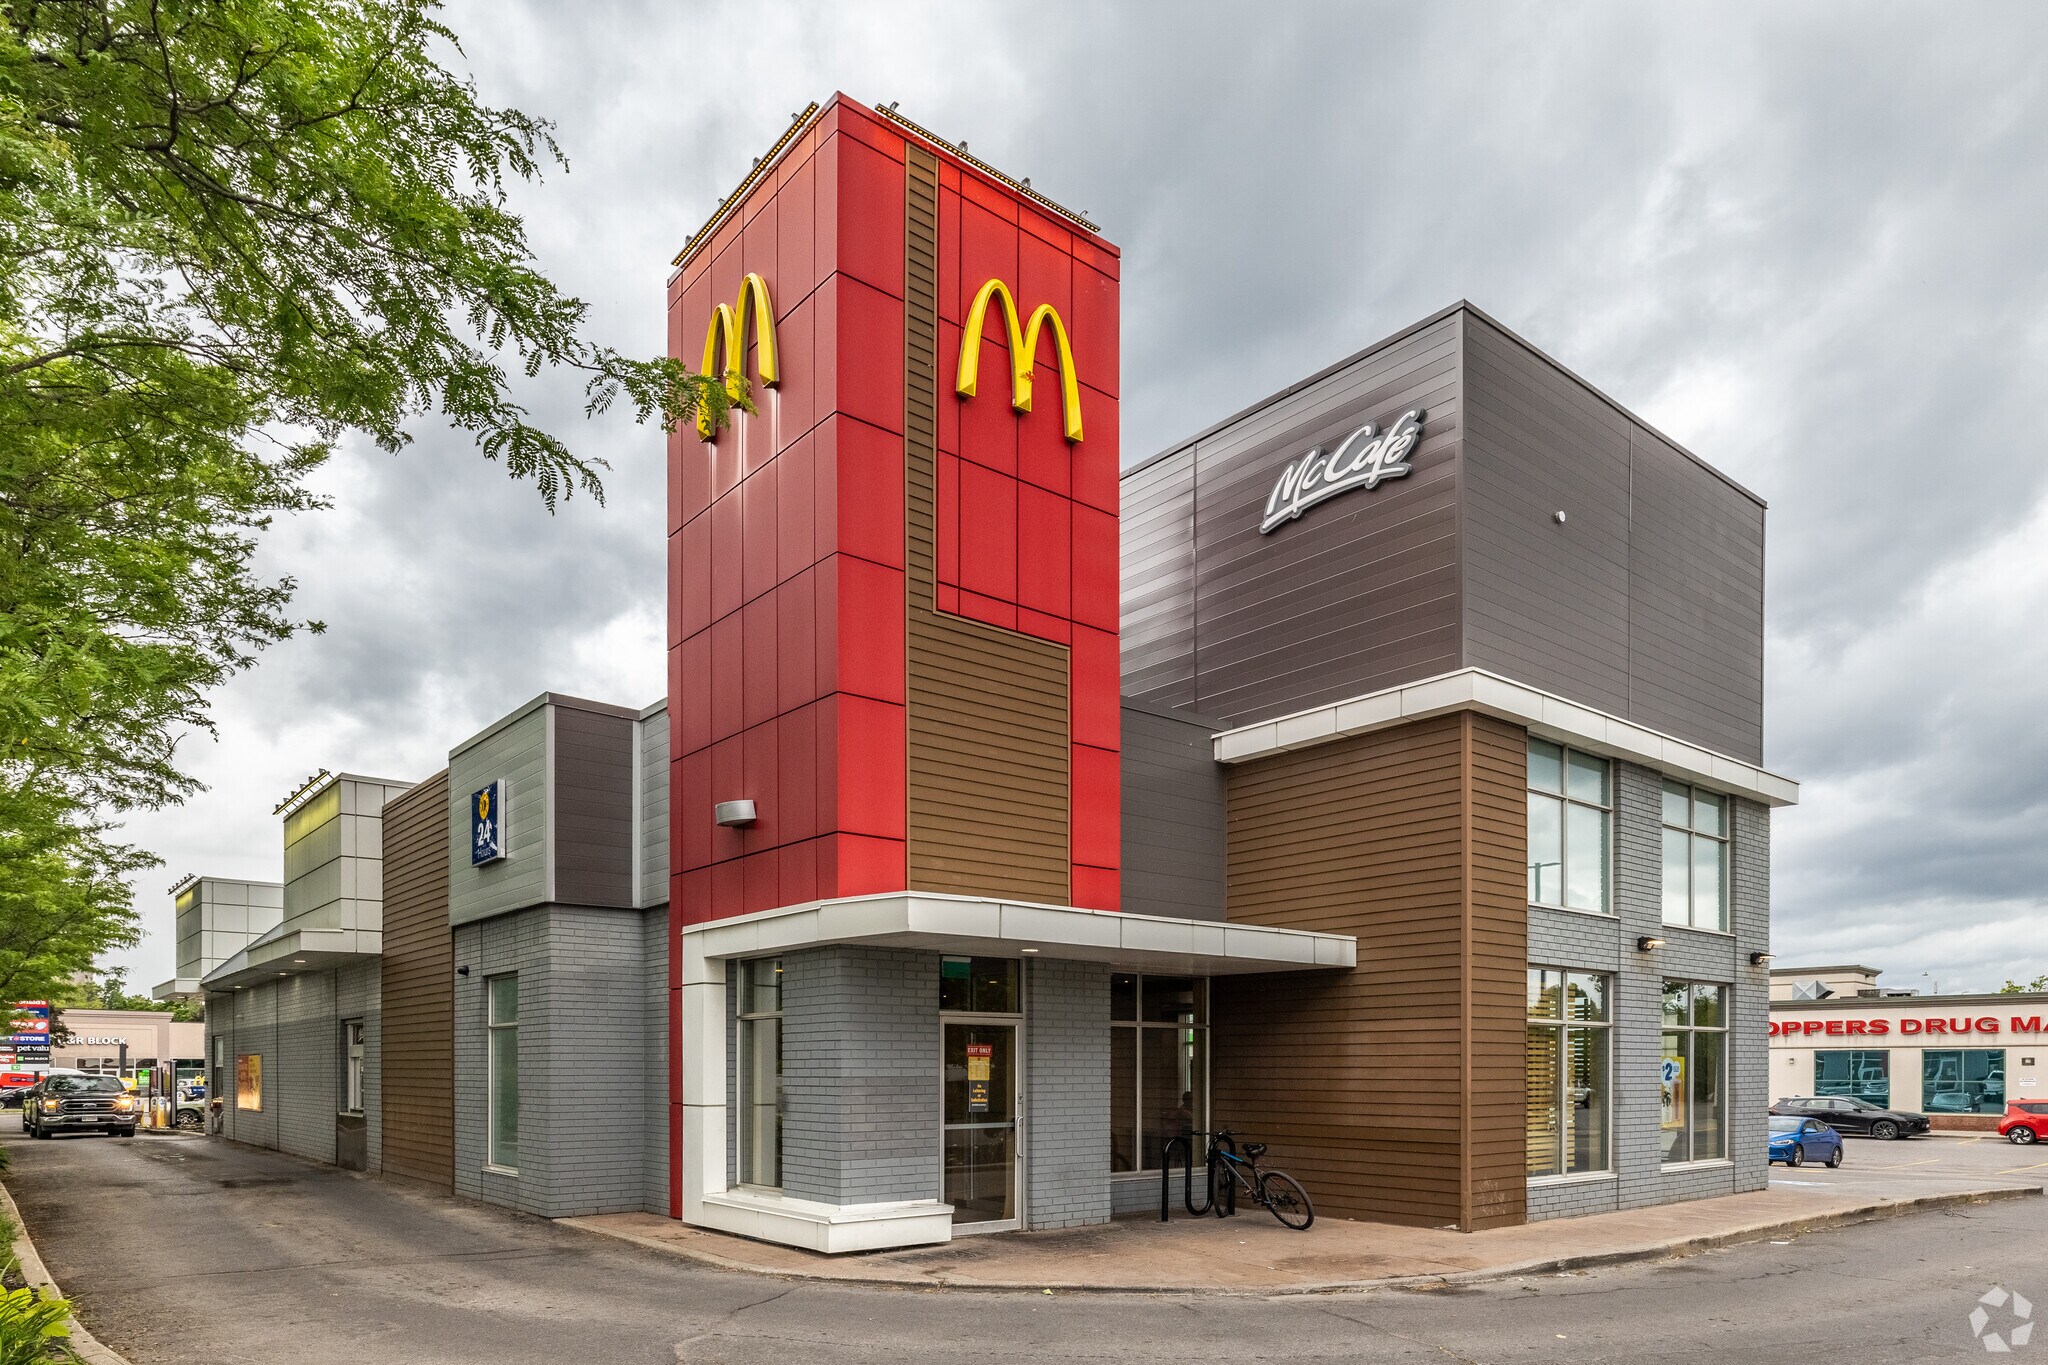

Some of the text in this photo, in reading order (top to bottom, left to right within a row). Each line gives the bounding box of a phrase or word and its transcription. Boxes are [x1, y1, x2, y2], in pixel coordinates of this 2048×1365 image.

[1264, 410, 1418, 522] McCafé
[1900, 1017, 2000, 1034] DRUG
[2010, 1016, 2048, 1033] M
[88, 1037, 126, 1045] BLOCK
